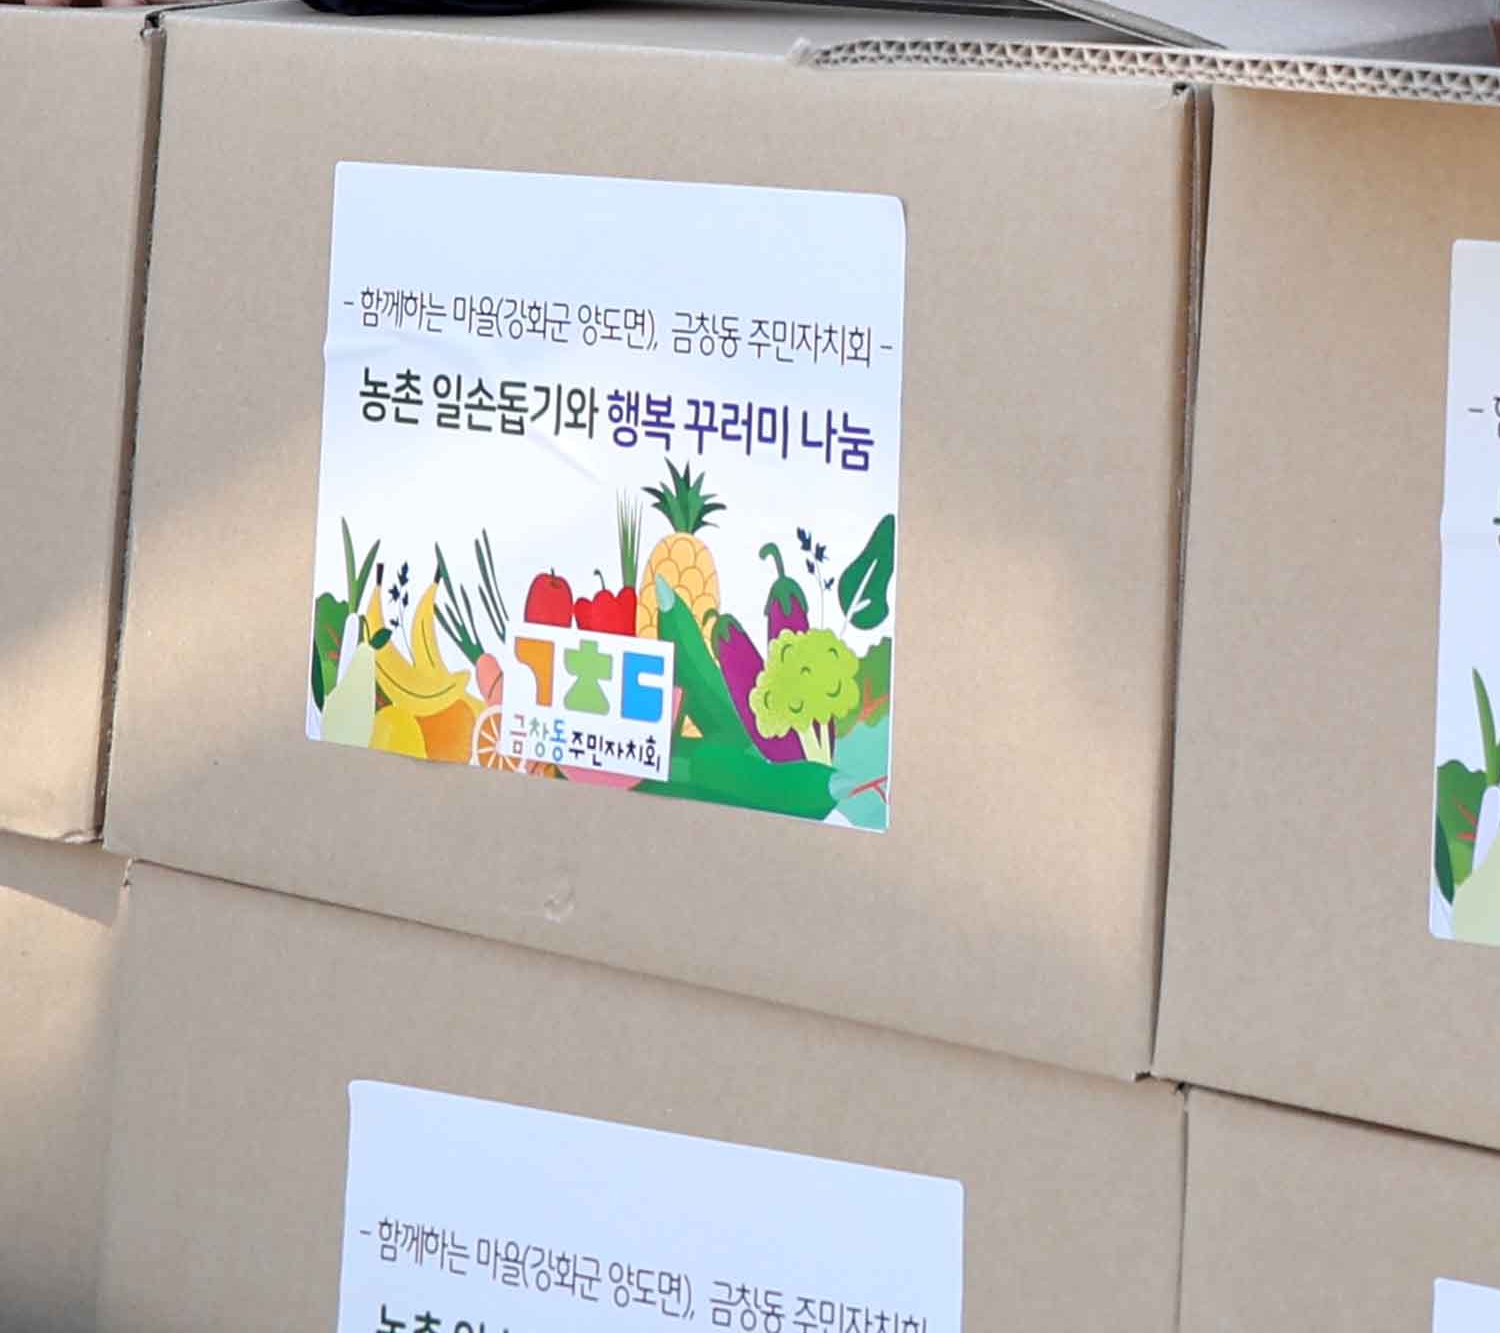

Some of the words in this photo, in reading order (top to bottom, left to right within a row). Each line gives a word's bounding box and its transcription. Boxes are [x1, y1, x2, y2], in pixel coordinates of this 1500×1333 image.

[360, 286, 448, 334] 함께하는
[453, 294, 572, 344] 마을(강화군
[671, 311, 742, 359] 금창동
[747, 319, 872, 369] 주민자치회
[359, 366, 424, 425] 농촌
[432, 373, 600, 440] 일손돕기와
[606, 388, 676, 452] 행복
[683, 398, 789, 460] 꾸러미
[801, 409, 875, 472] 나눔
[378, 1216, 470, 1276] 함께하는
[476, 1238, 602, 1302] 마을(강화군
[709, 1280, 786, 1333] 금창동
